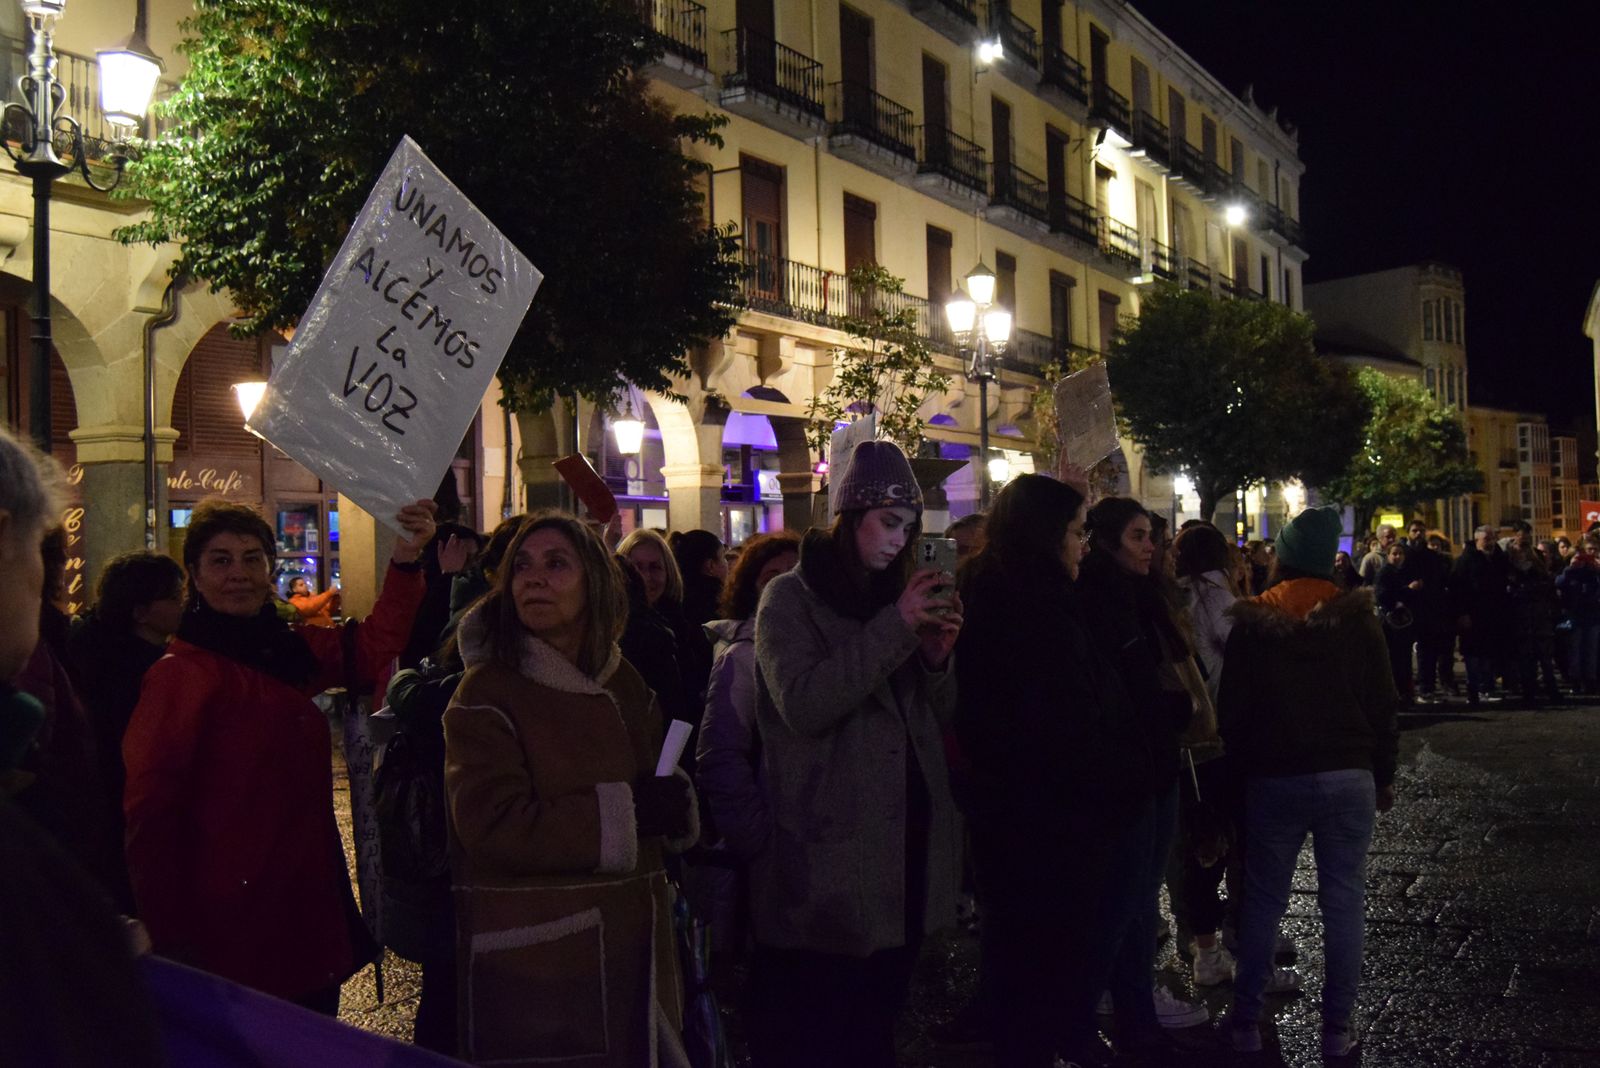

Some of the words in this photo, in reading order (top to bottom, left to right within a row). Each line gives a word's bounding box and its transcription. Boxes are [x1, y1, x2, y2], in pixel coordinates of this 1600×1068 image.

[394, 177, 502, 294] UNAMOS
[420, 257, 443, 289] Y
[352, 247, 480, 369] ALCEMOS
[376, 326, 406, 369] La
[343, 346, 418, 435] VOZ
